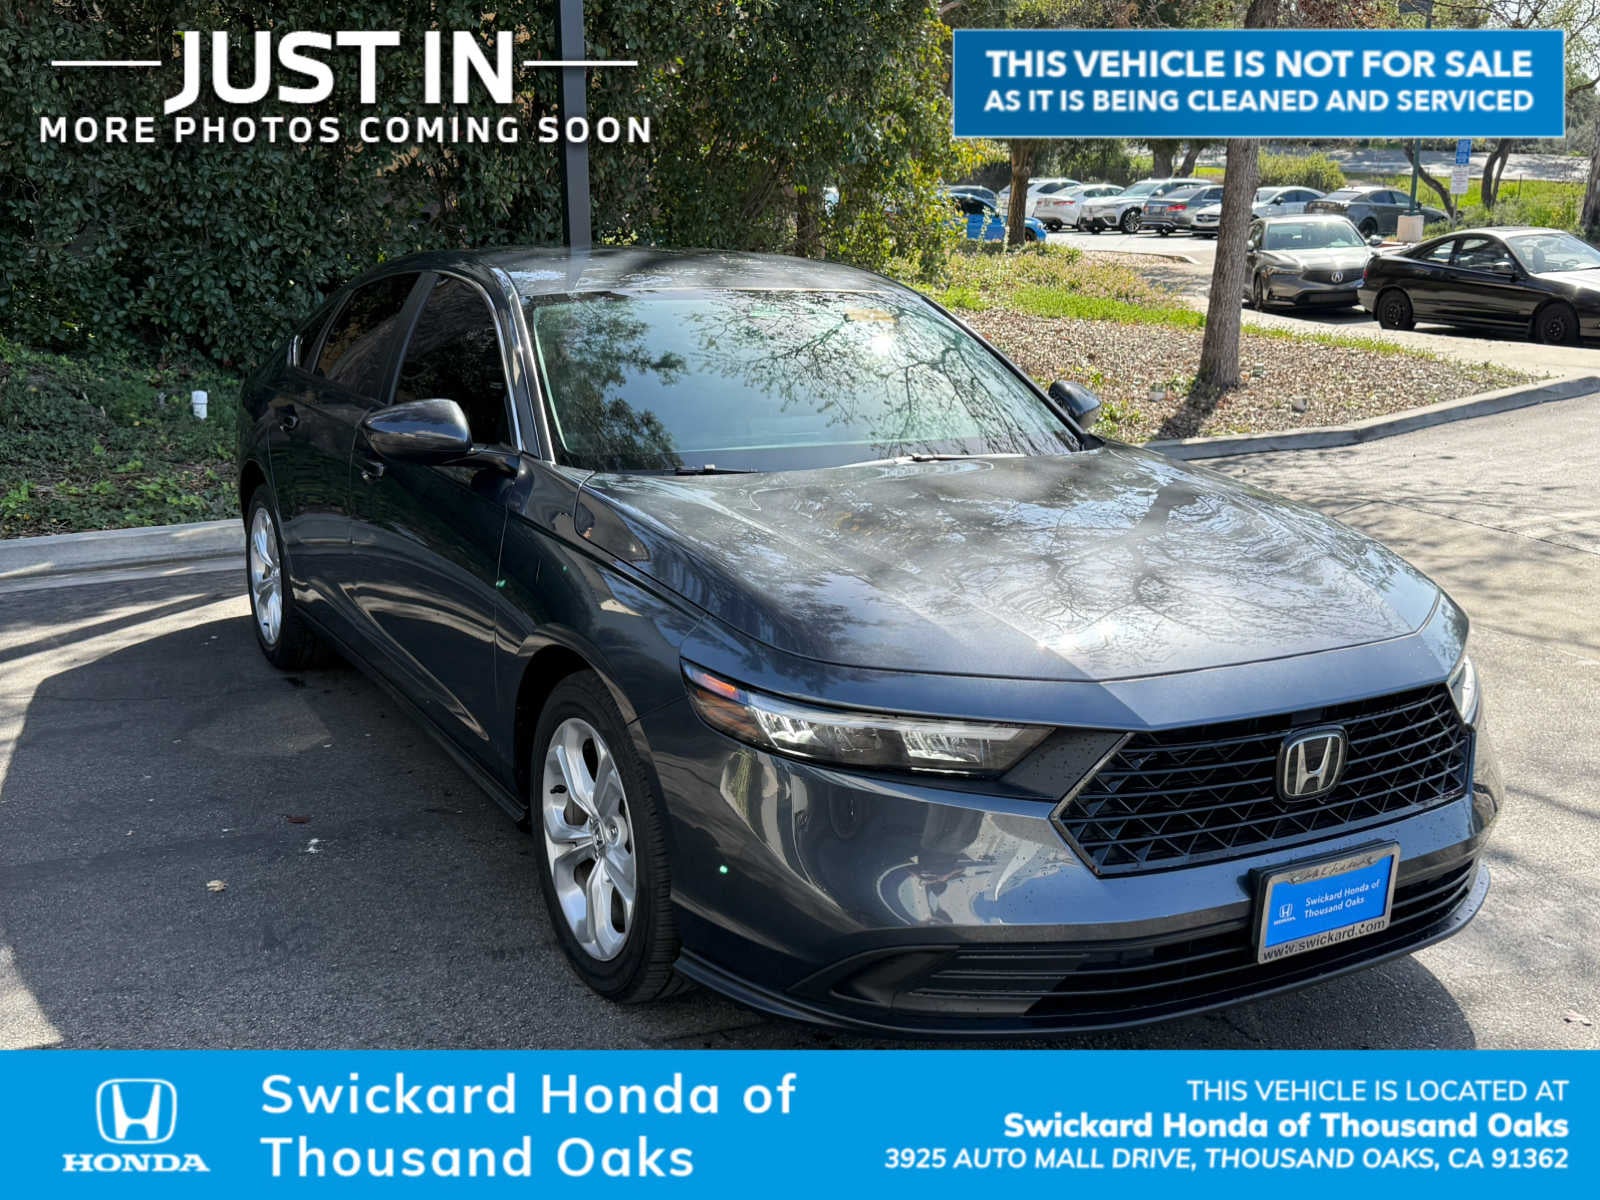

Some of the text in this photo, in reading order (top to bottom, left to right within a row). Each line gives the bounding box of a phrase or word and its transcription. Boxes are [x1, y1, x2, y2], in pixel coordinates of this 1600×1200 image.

[1305, 879, 1381, 907] Swickard Honda of
[1304, 896, 1365, 919] Thousand Oaks
[1263, 919, 1385, 960] www.swickard.com
